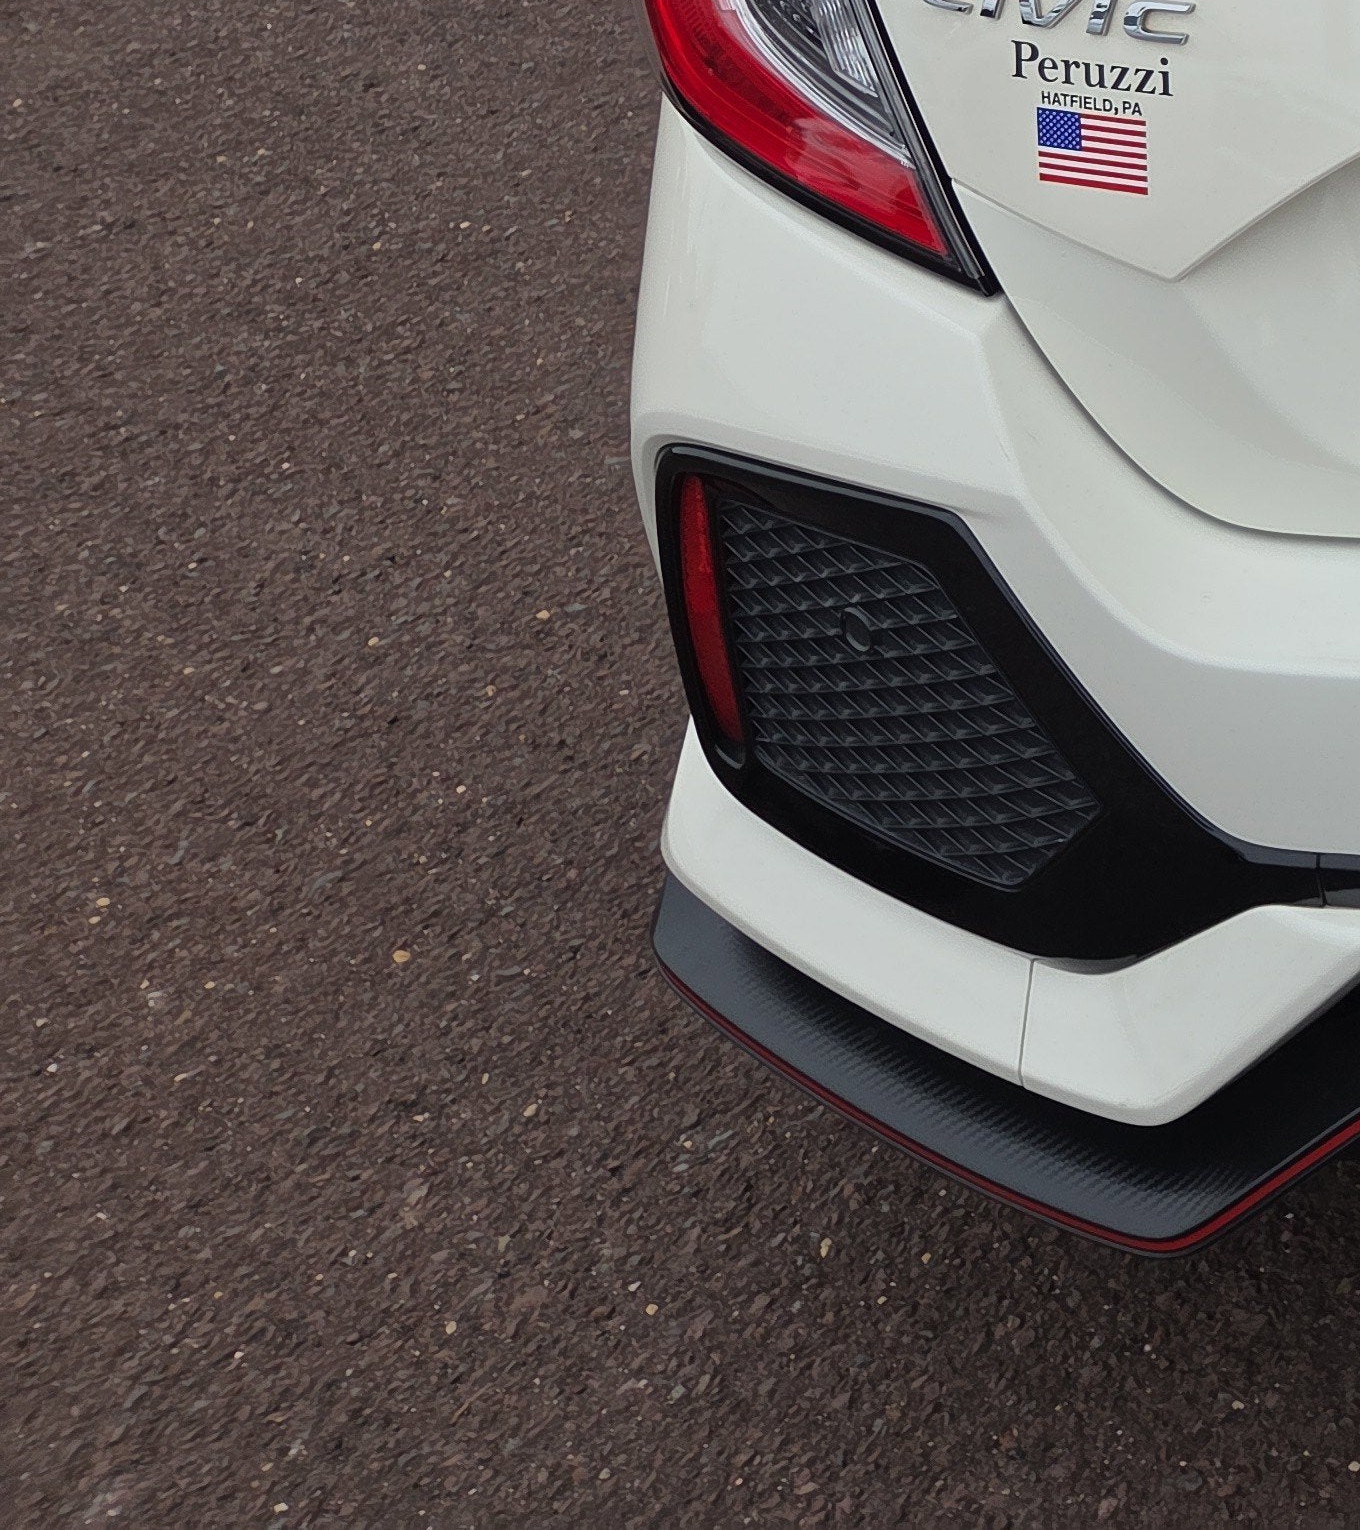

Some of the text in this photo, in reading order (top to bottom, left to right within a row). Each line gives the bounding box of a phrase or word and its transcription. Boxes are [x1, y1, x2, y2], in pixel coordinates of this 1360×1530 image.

[1010, 39, 1174, 97] Peruzzi
[1041, 90, 1143, 116] HATFIELD, PA
